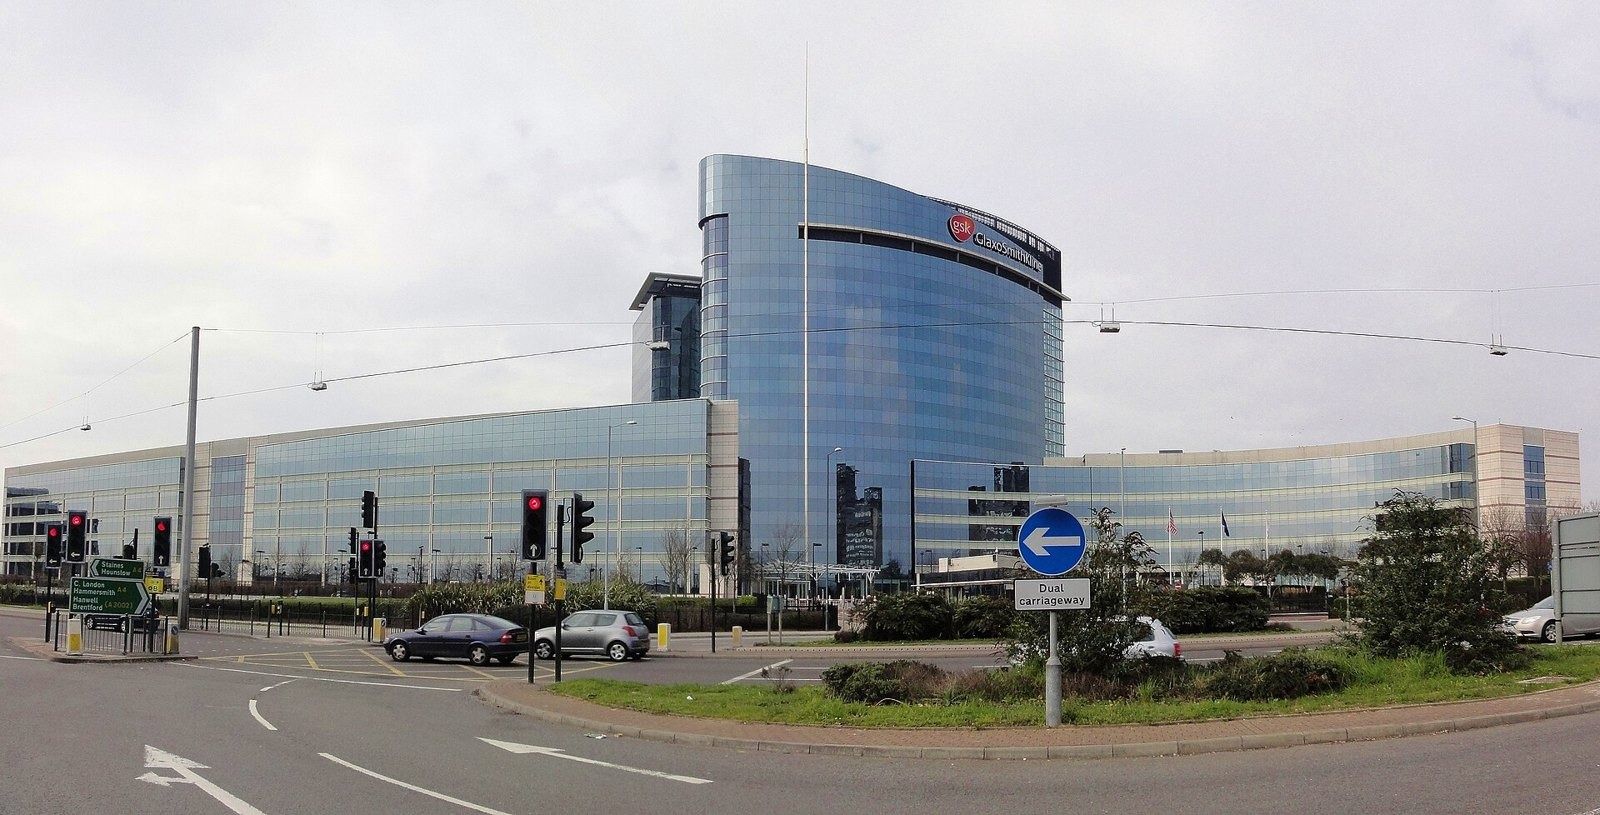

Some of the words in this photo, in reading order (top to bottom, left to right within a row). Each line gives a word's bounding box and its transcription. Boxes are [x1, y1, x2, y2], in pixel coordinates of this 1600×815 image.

[953, 220, 971, 235] gsk
[974, 232, 1042, 273] GlaxoSmithKline
[101, 561, 124, 569] Staines
[101, 568, 131, 576] Hounslow
[82, 580, 105, 588] London
[1039, 583, 1065, 593] Dual
[73, 587, 116, 596] Hammersmith
[73, 596, 99, 604] Hanwell
[1019, 596, 1085, 607] carriageway
